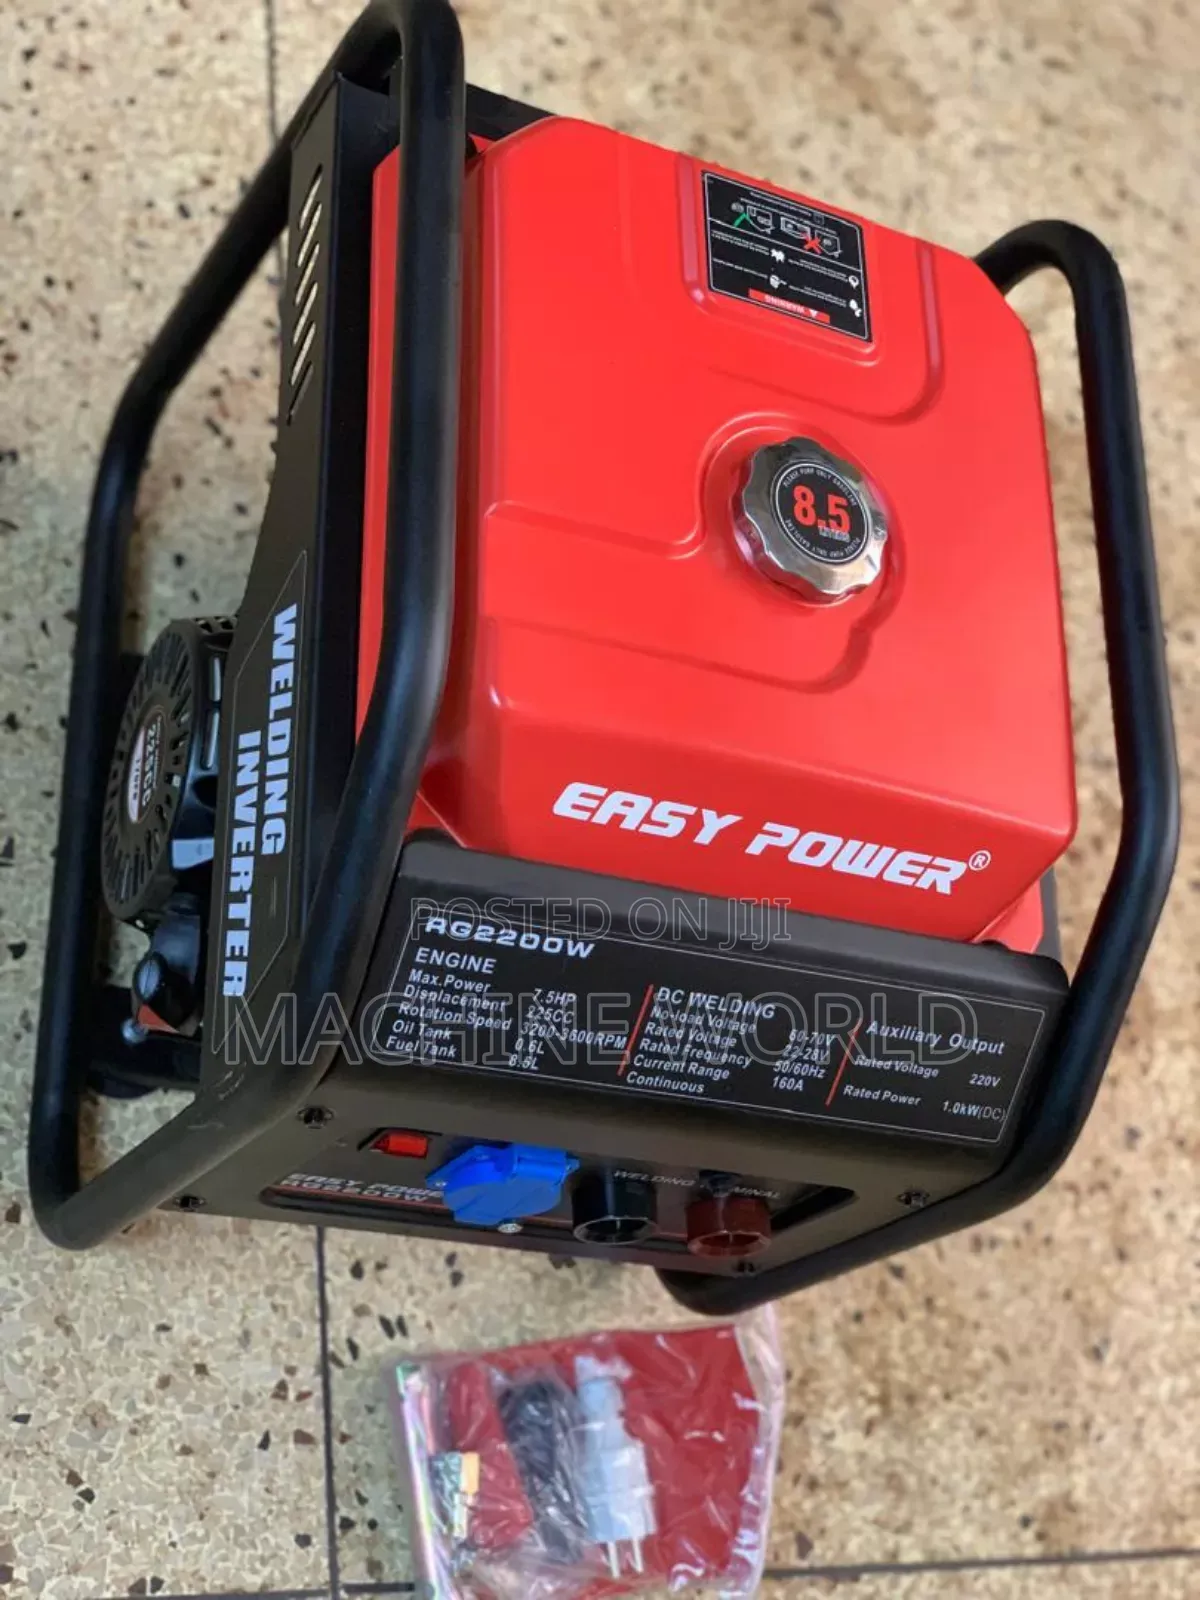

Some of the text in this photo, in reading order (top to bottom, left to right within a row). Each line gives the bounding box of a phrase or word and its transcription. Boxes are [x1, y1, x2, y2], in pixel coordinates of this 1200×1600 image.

[793, 484, 850, 534] 8.5
[261, 603, 299, 856] WELDING
[552, 781, 744, 846] EASY
[222, 729, 262, 997] INVERTER
[424, 915, 596, 959] RG2200W
[413, 946, 498, 975] ENGINE
[402, 984, 575, 1024] Displacement 225CC
[532, 987, 577, 1006] 7.5HP
[655, 986, 776, 1020] DC WELDING
[397, 1002, 464, 1025] Rotation
[465, 1011, 513, 1032] Speed
[649, 1005, 705, 1026] No-load
[706, 1013, 757, 1035] Voltage
[385, 1036, 540, 1071] Fuel Tank 8.5L
[391, 1019, 545, 1055] Oil Tank 0.6L
[644, 1021, 830, 1062] Rated Voltage 22-28V
[866, 1020, 1005, 1056] Auxiliary Output
[633, 1053, 804, 1093] Current Range 160A
[638, 1037, 680, 1057] Rated
[773, 1059, 826, 1079] 50/60Hz
[854, 1055, 1001, 1088] Rated Voltage 220V
[626, 1070, 706, 1094] Continuous
[843, 1084, 1007, 1124] Rated Power 1.0kW(DC)
